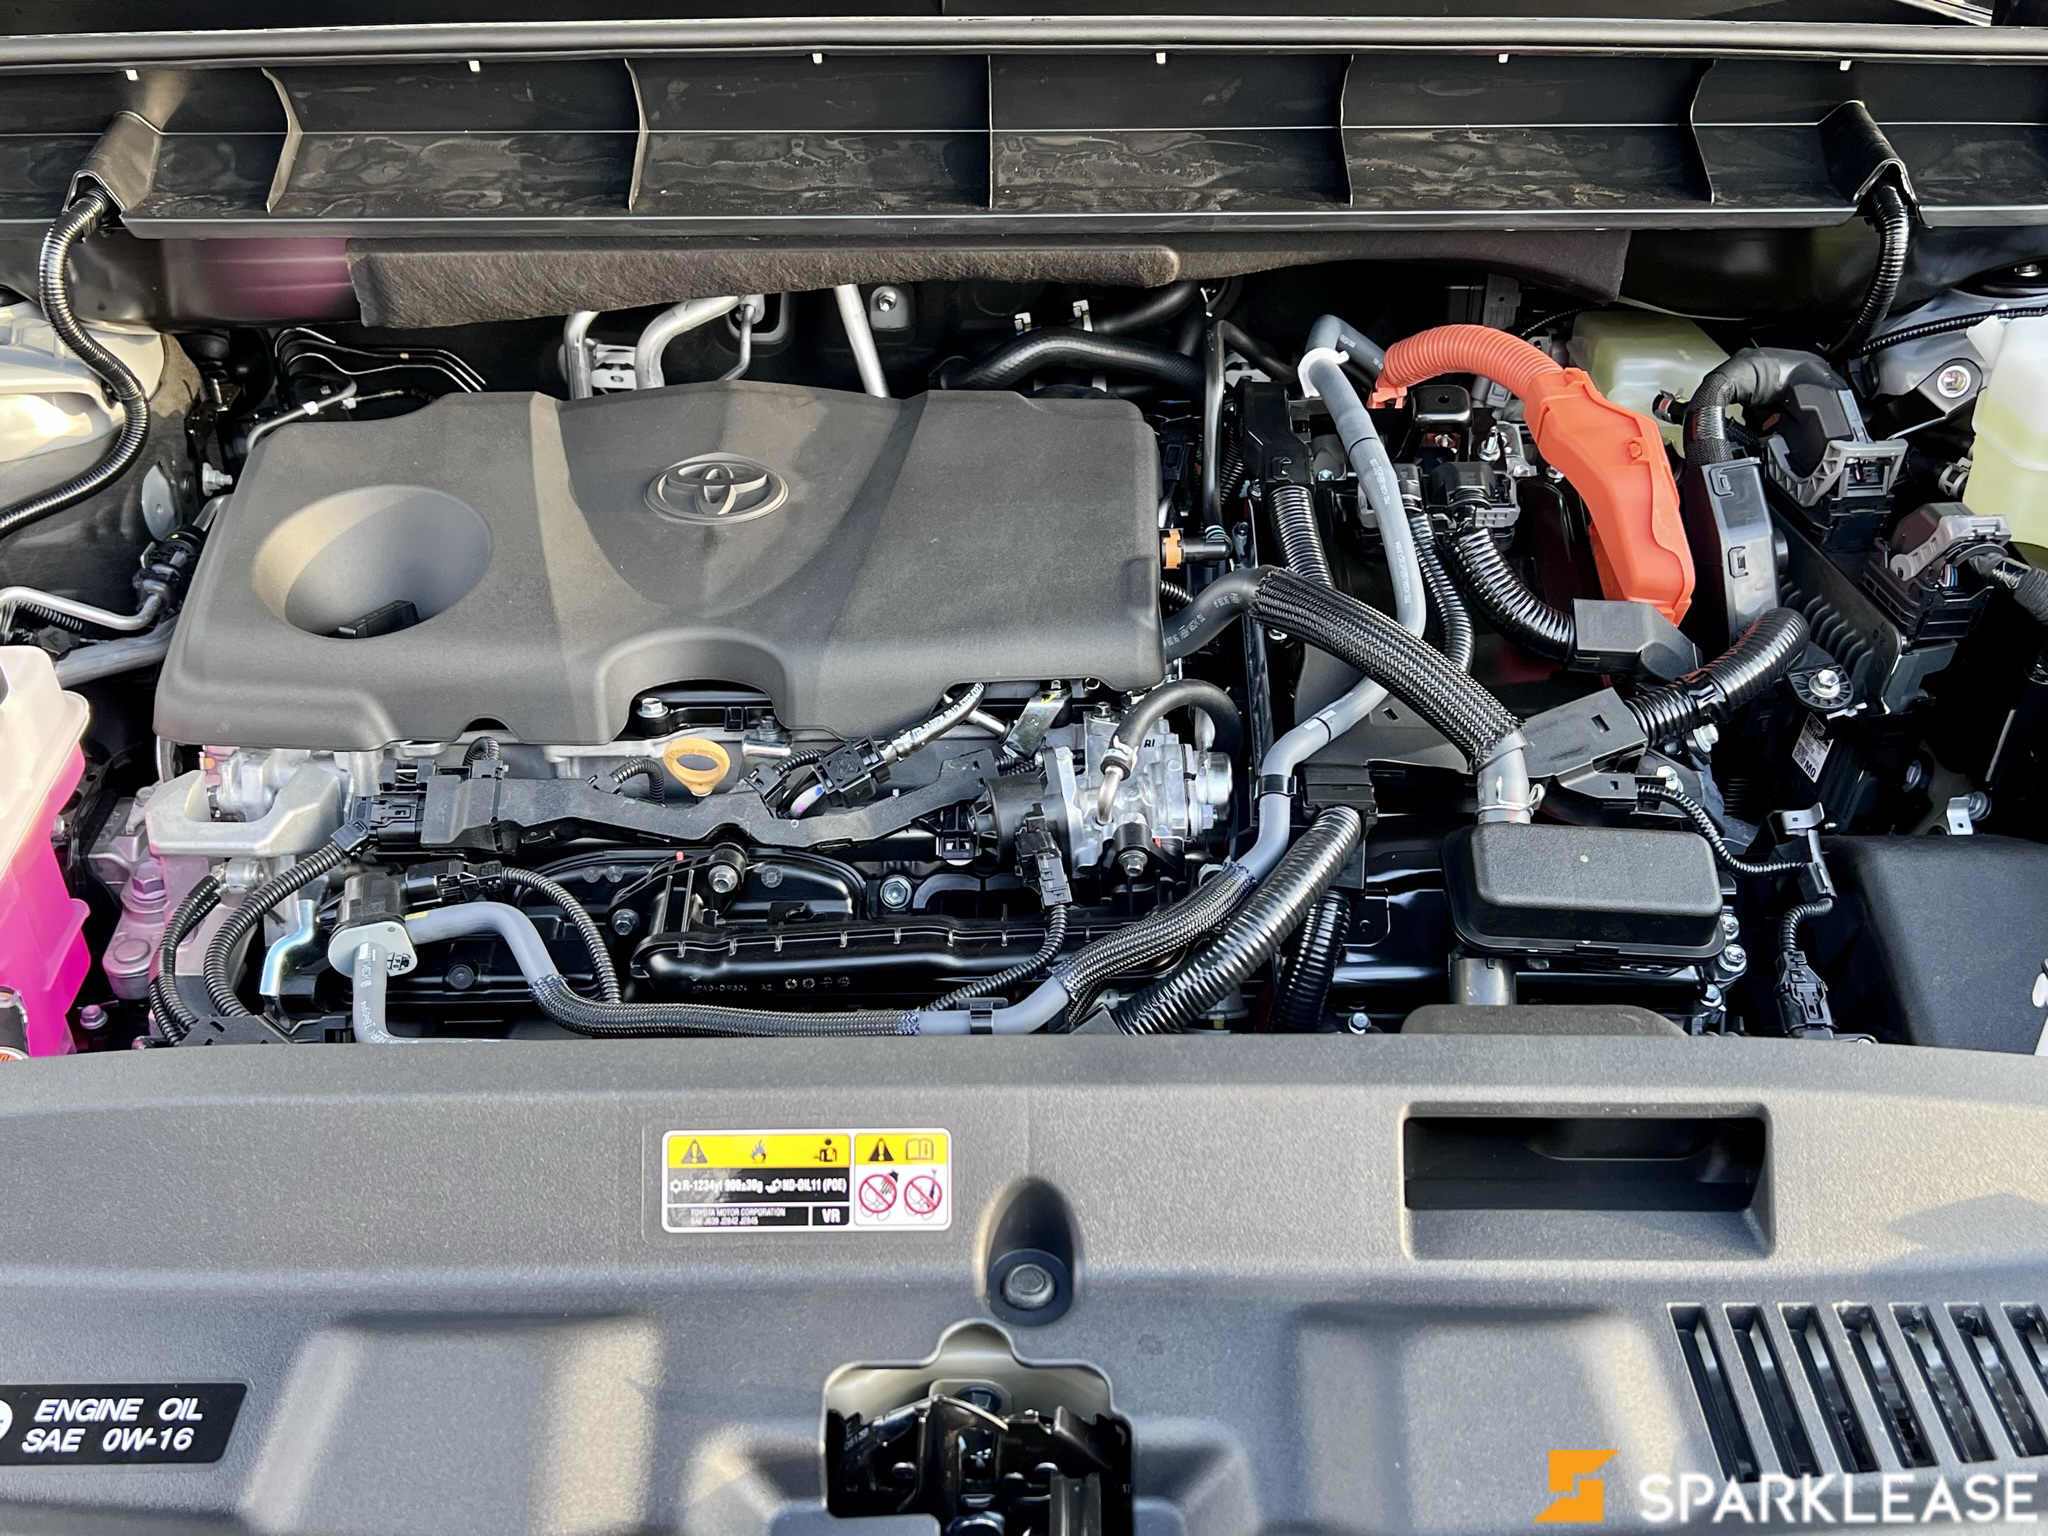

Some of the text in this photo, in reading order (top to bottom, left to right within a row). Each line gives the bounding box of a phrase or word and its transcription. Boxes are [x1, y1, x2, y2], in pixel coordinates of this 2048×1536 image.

[821, 1208, 841, 1223] VR
[34, 1397, 203, 1422] ENGINE OIL
[22, 1427, 194, 1452] SAE 0W-16
